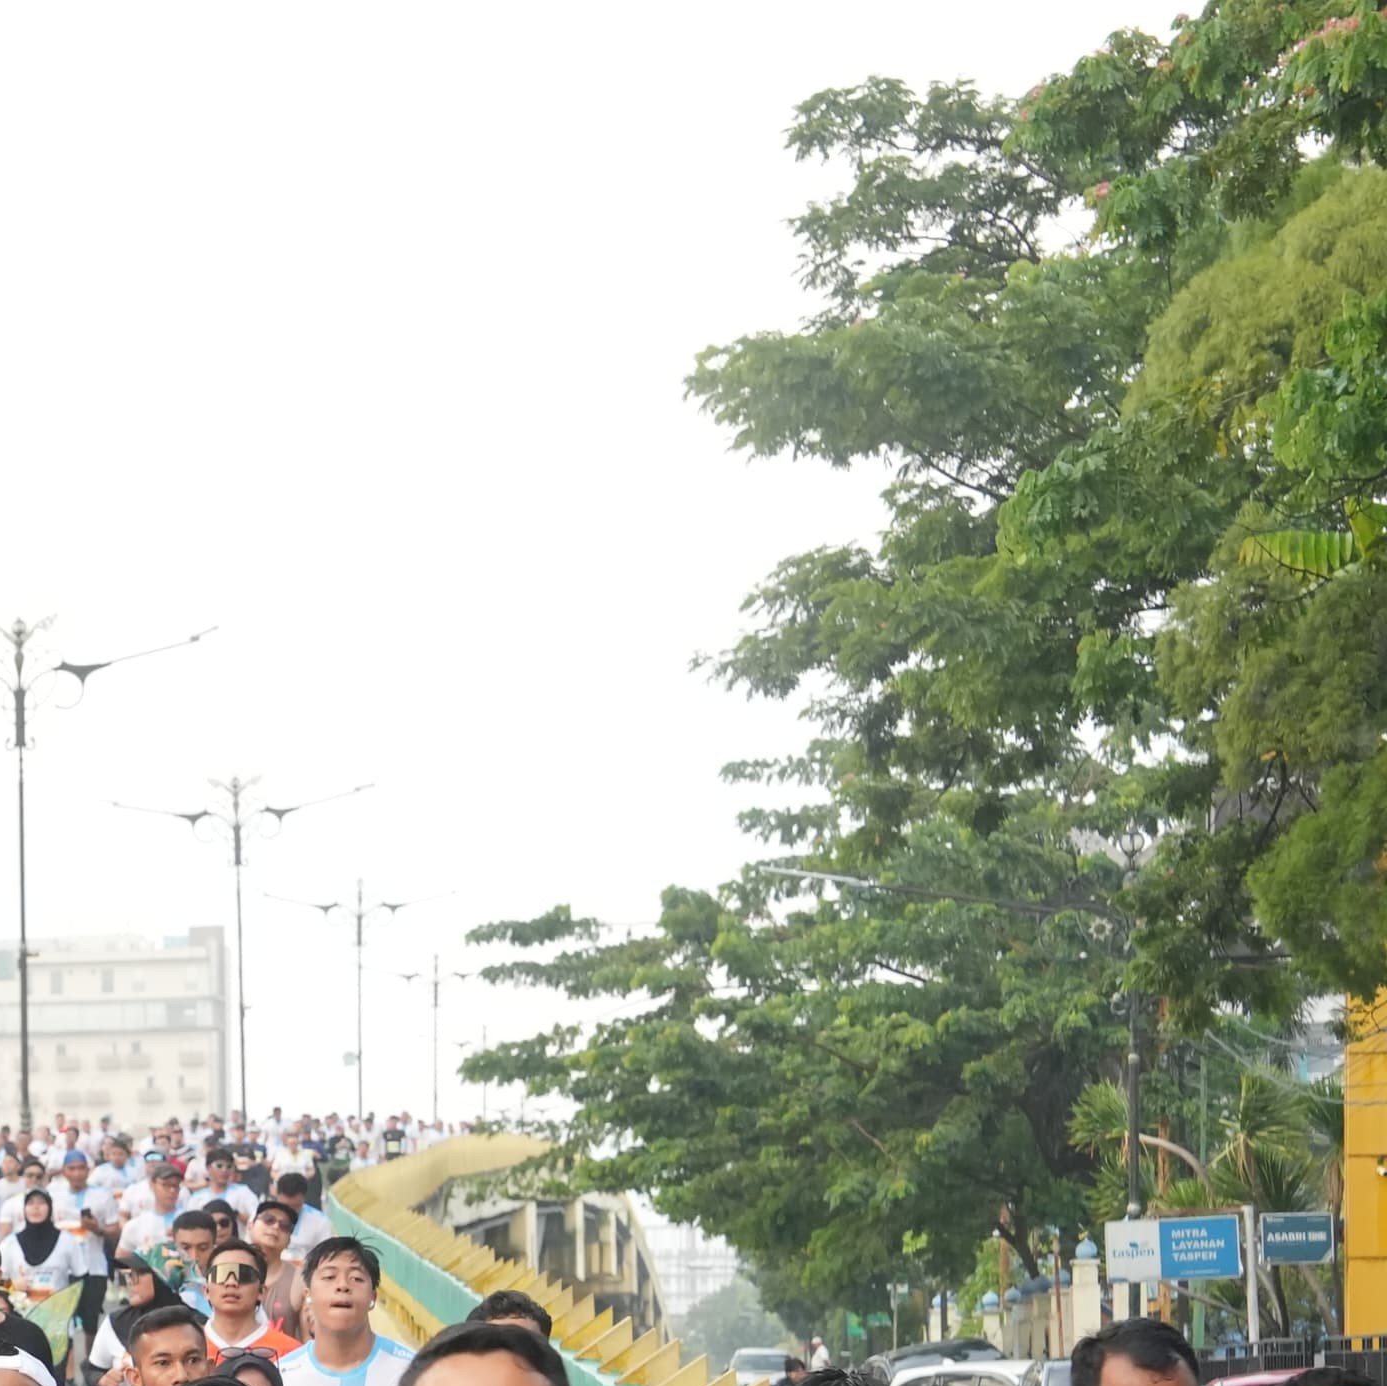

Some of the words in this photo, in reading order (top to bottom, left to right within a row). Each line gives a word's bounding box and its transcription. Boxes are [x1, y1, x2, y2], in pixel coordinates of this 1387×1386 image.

[1171, 1228, 1207, 1239] MITRA
[1267, 1231, 1306, 1242] ASABRI
[1172, 1239, 1225, 1250] LAYANAN
[1112, 1246, 1155, 1261] taspen
[1171, 1250, 1217, 1261] TASPEN
